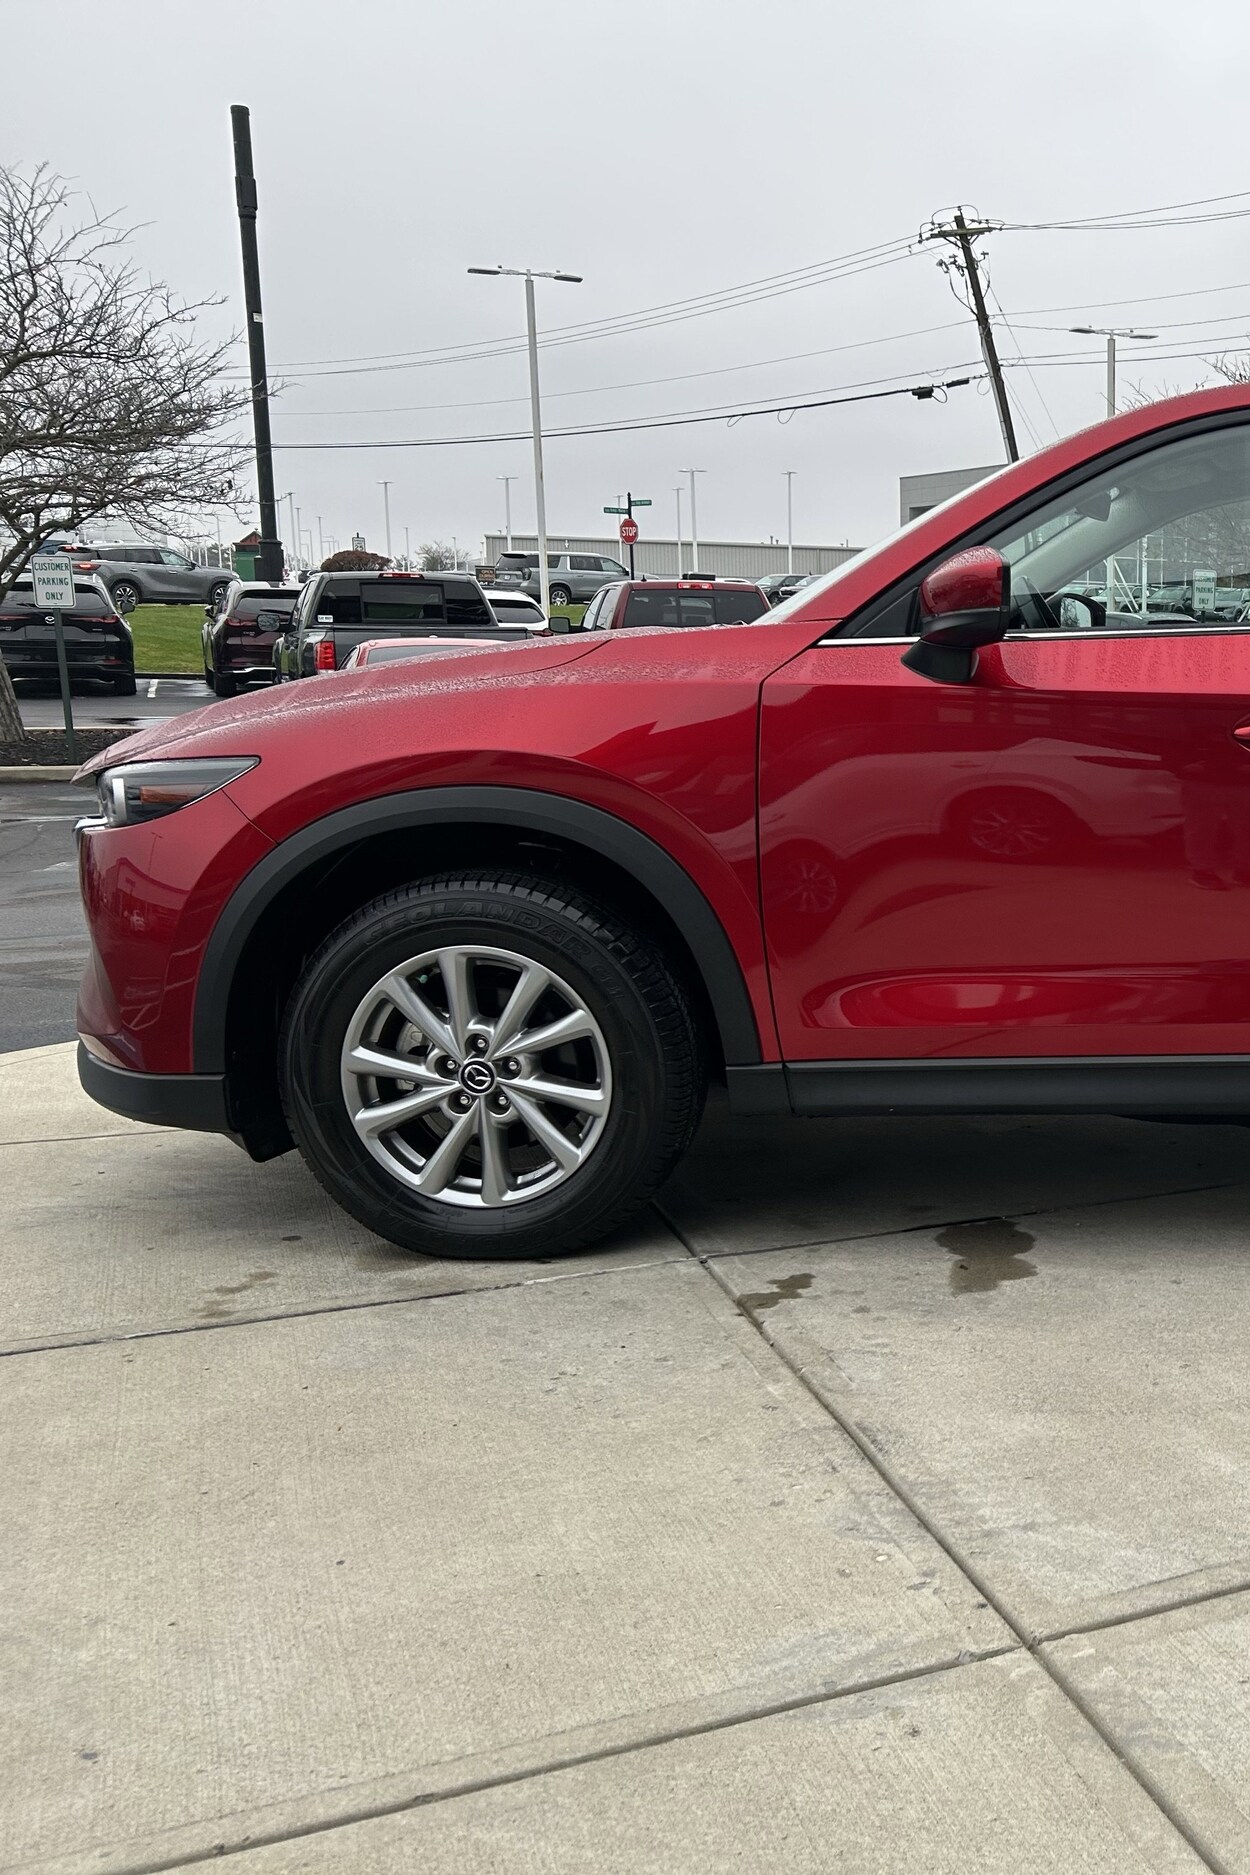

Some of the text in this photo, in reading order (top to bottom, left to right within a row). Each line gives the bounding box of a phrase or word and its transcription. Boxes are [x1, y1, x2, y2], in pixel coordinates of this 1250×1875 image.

[621, 526, 637, 537] STOP
[34, 562, 70, 571] CUSTOMER
[37, 577, 69, 586] PARKING
[45, 591, 63, 600] ONLY
